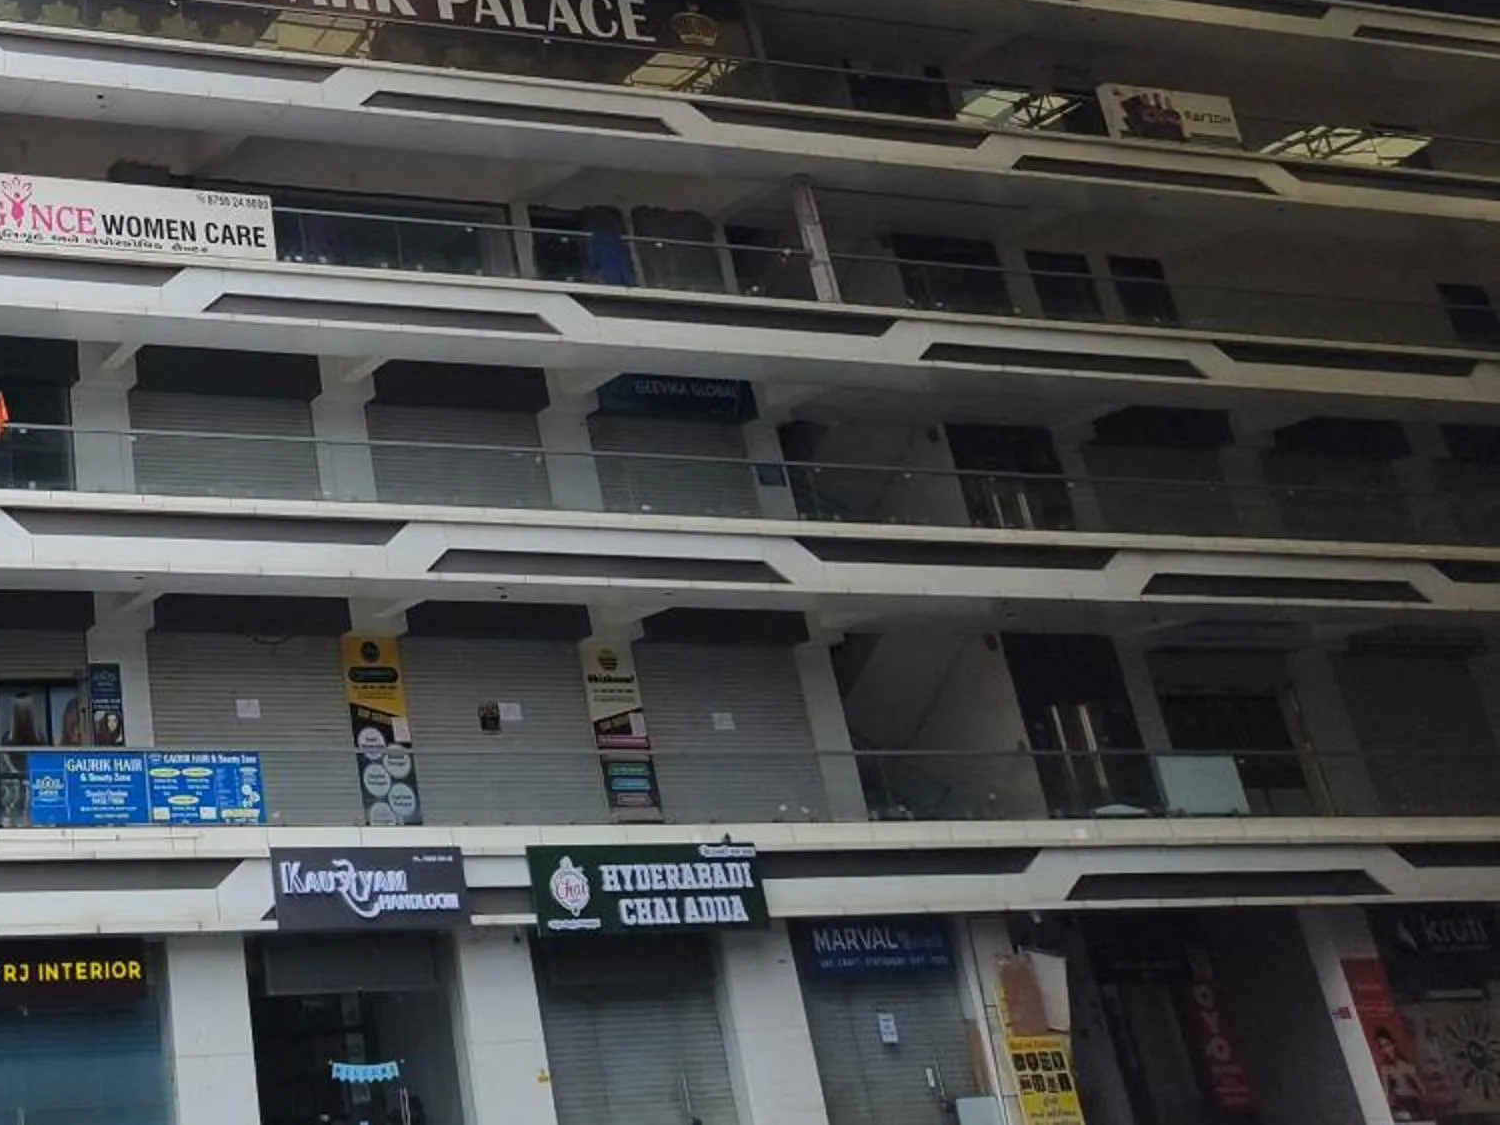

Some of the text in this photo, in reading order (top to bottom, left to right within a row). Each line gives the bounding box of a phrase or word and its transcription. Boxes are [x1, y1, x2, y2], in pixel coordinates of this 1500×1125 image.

[102, 214, 197, 242] WOMEN
[205, 222, 267, 248] CARE
[67, 758, 143, 772] GAURIK HAIR
[600, 862, 754, 891] HYDERABADI
[377, 893, 460, 910] HANDLOOM
[618, 897, 681, 925] CHAI
[684, 895, 749, 923] ADDA
[812, 926, 899, 954] MARVAL
[3, 960, 142, 982] RJ INTERIOR
[1192, 984, 1233, 1062] OYO
